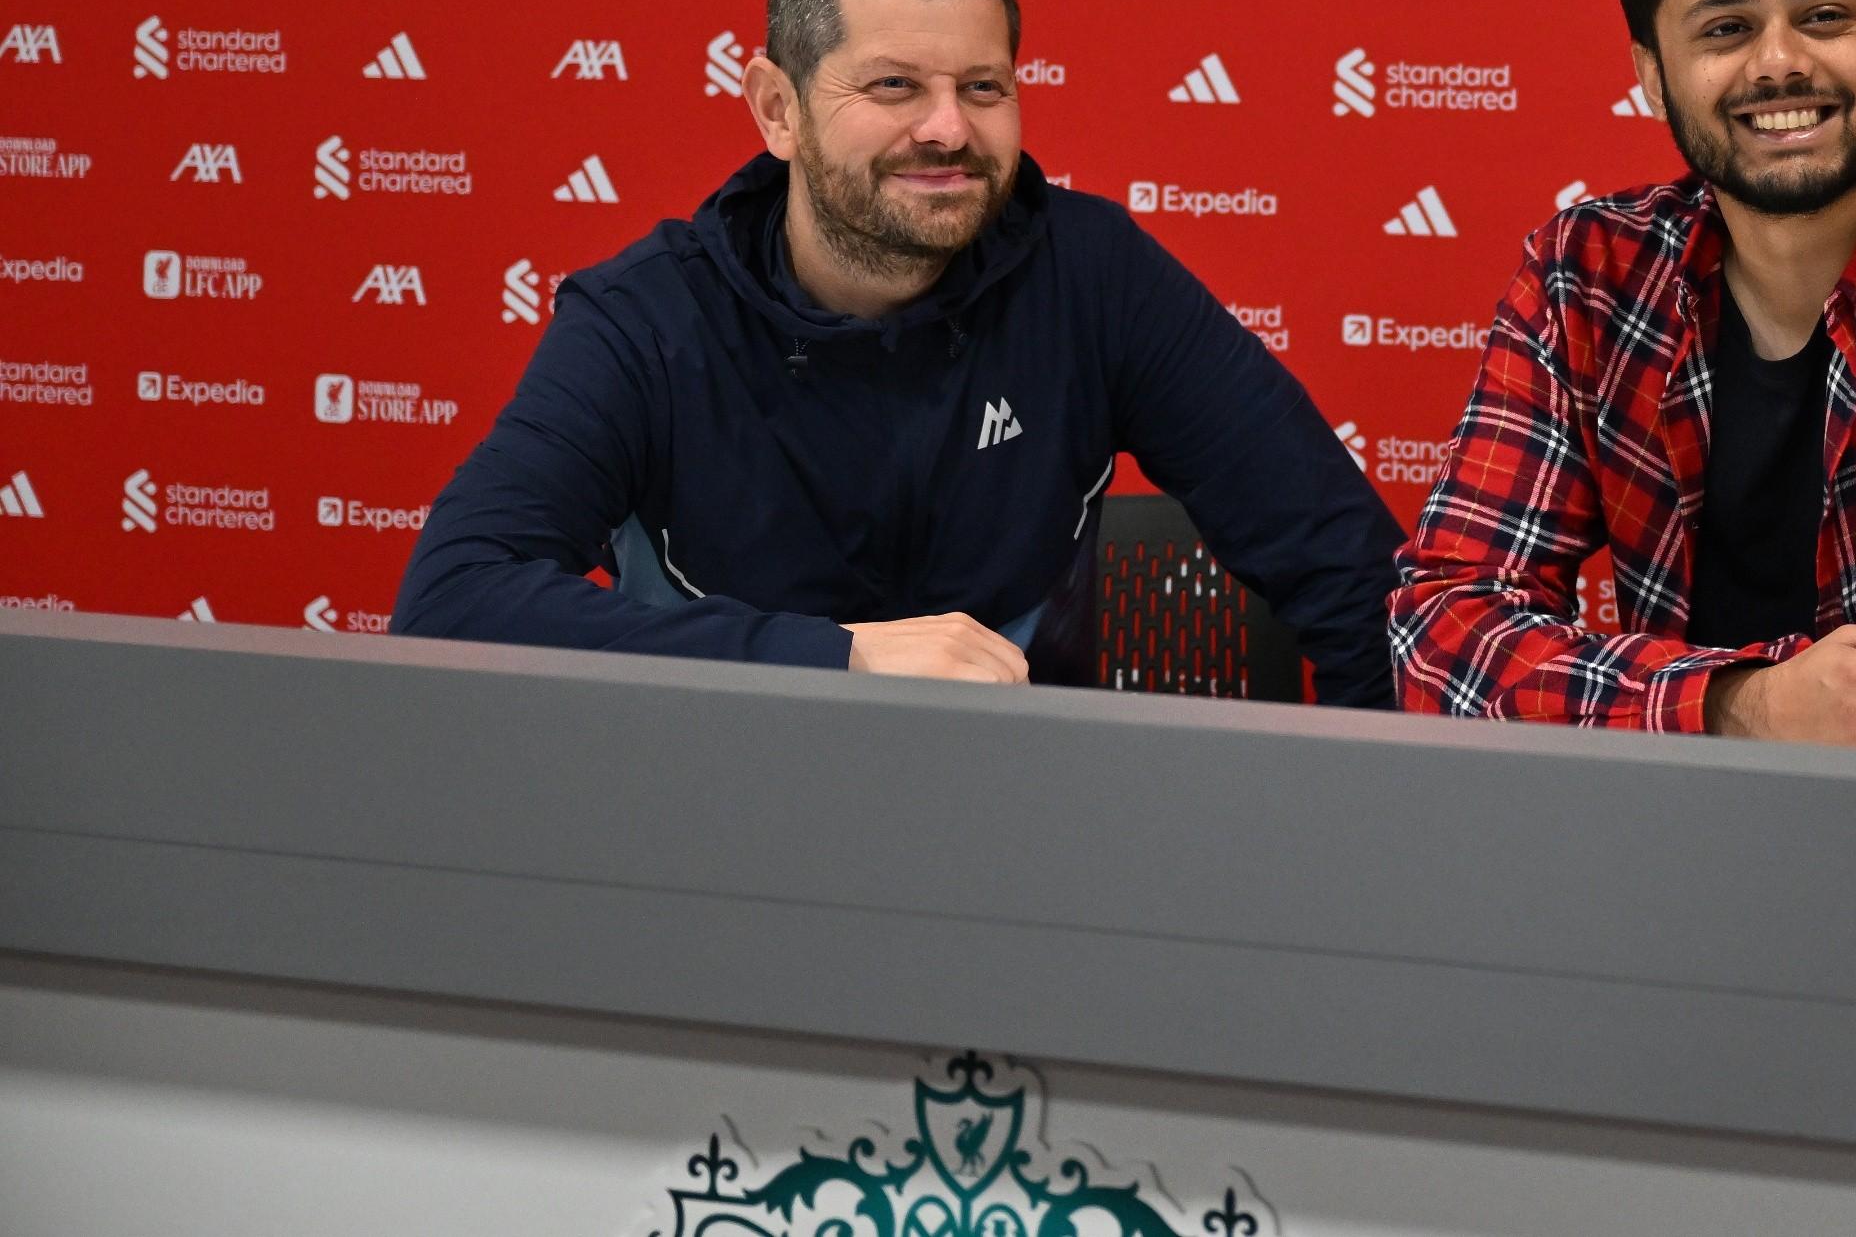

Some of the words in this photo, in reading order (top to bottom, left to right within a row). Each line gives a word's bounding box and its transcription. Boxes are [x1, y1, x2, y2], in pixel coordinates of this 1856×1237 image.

[178, 28, 280, 52] standard
[177, 51, 286, 73] chartered
[551, 40, 628, 81] AXA
[1386, 61, 1510, 87] standard
[1385, 86, 1517, 111] chartered
[55, 153, 92, 179] APP
[170, 143, 242, 184] AXA
[360, 149, 465, 173] standard
[359, 171, 472, 195] chartered
[1162, 184, 1277, 217] Expedia
[185, 272, 219, 298] LFC
[222, 272, 263, 299] APP
[352, 264, 427, 306] AXA
[166, 375, 265, 406] Expedia
[358, 397, 417, 423] STORE
[419, 400, 458, 424] APP
[166, 483, 268, 509] standard
[165, 505, 274, 531] chartered
